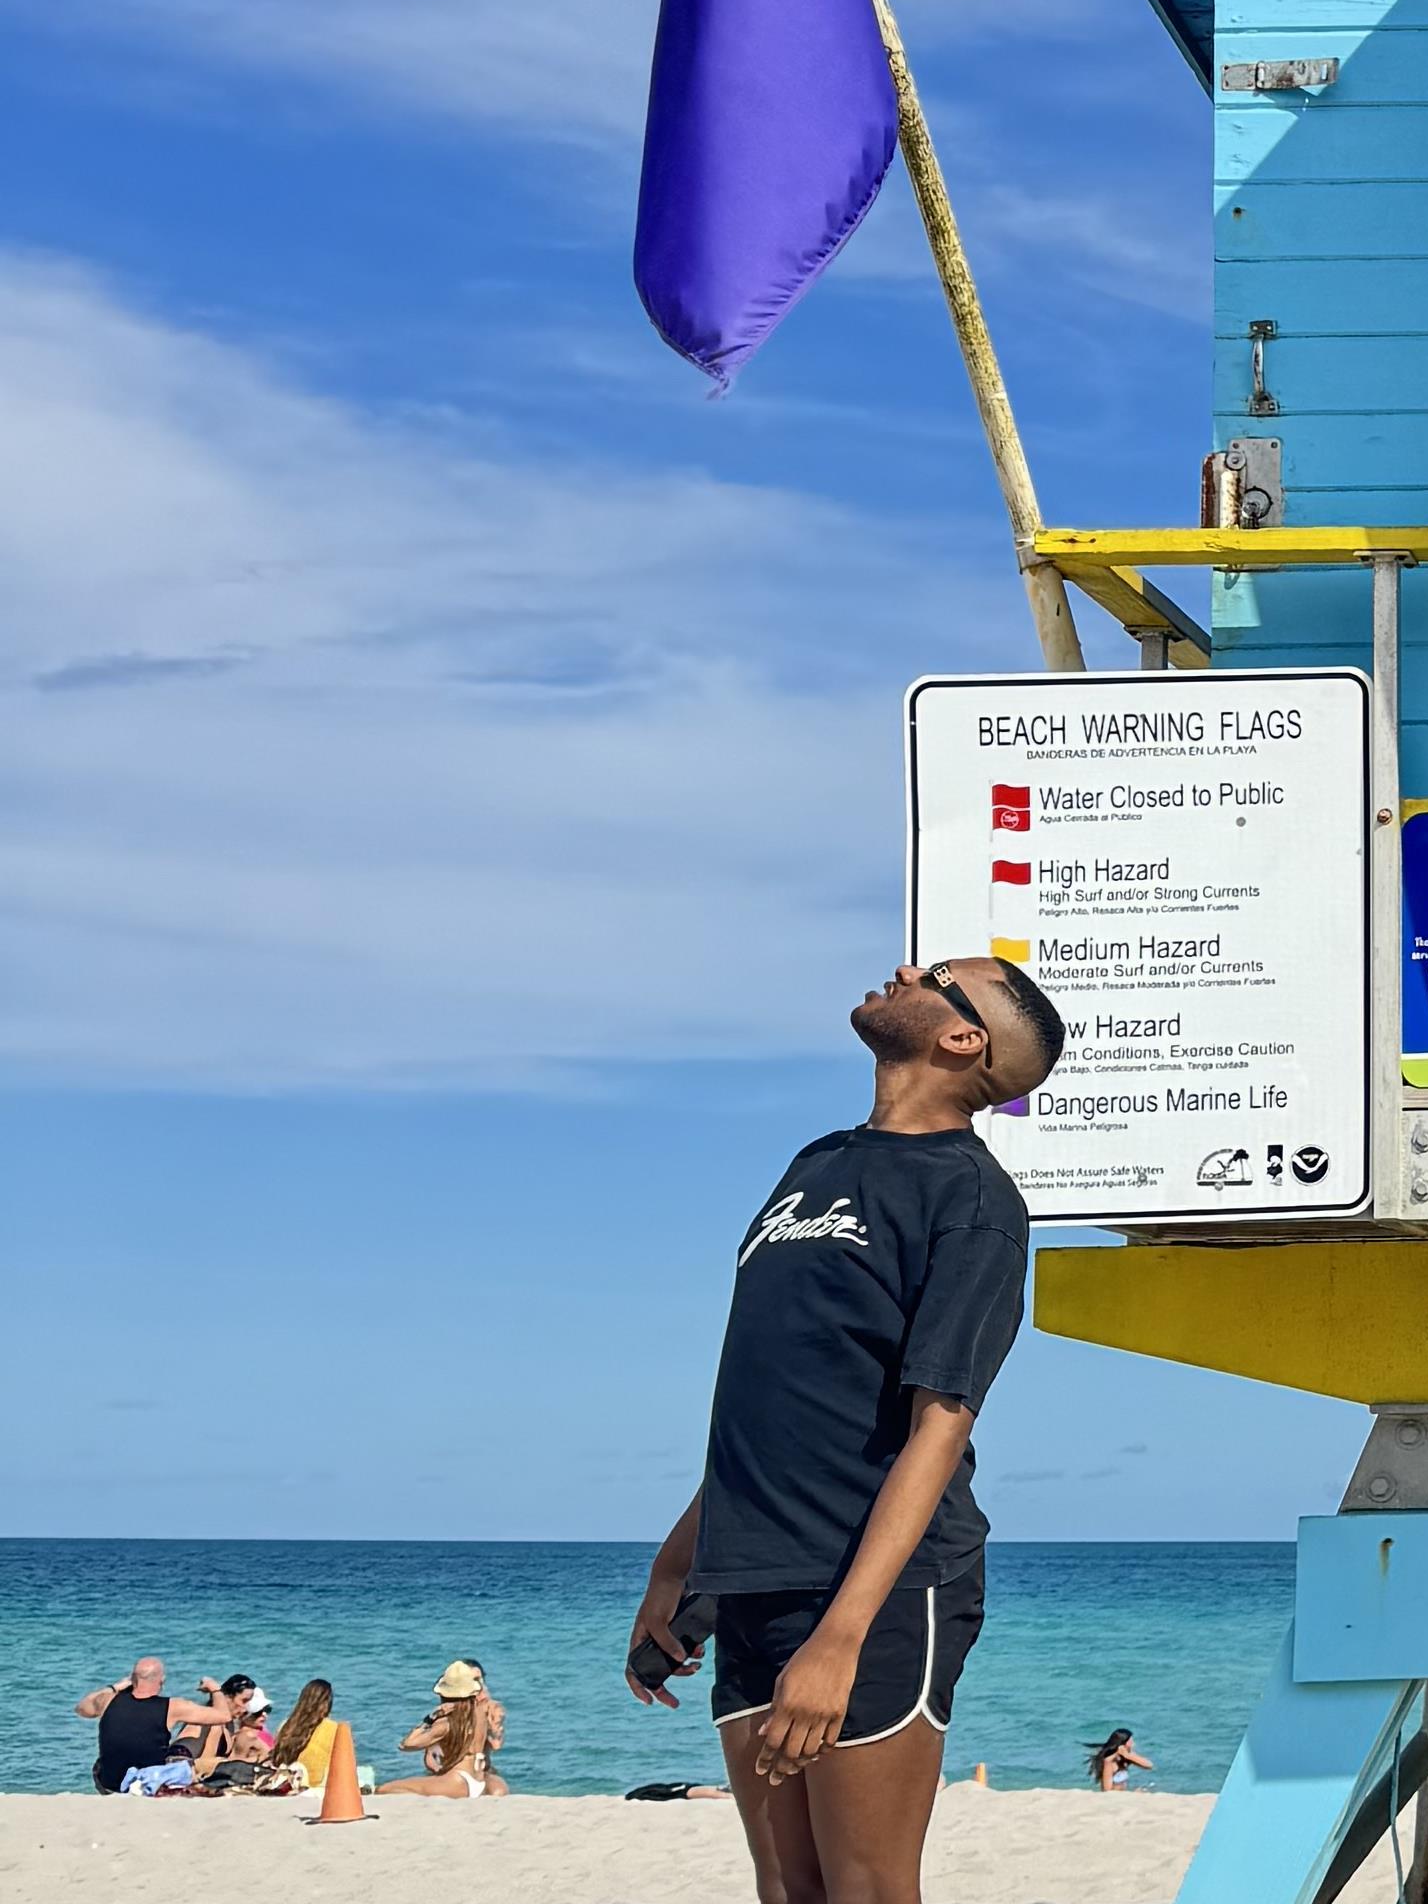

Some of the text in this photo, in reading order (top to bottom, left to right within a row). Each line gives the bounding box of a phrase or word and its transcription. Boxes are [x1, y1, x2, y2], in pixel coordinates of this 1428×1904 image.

[979, 709, 1302, 746] BEACH WARNING FLAGS
[1026, 745, 1257, 760] BANDERAS DE ADVERTENCIA EN LA PLAYA
[1039, 780, 1284, 810] Water Closed to Public
[1039, 815, 1062, 824] Agua
[1039, 857, 1169, 889] High Hazard
[1039, 885, 1260, 906] High Surf and/or Strong Currents
[1039, 933, 1221, 962] Medium Hazard
[1039, 959, 1264, 980] Moderate Surf and/or Currents
[1096, 1012, 1182, 1039] Hazard
[1082, 1047, 1165, 1061] Conditions,
[1170, 1044, 1234, 1058] Exercise
[1238, 1042, 1295, 1056] Caution
[1038, 1085, 1288, 1120] Dangerous Marine Life
[1030, 1169, 1055, 1179] Does
[1057, 1168, 1074, 1178] Not
[1076, 1167, 1109, 1177] Assure
[1111, 1166, 1131, 1176] Safe
[739, 1192, 868, 1267] Fender
